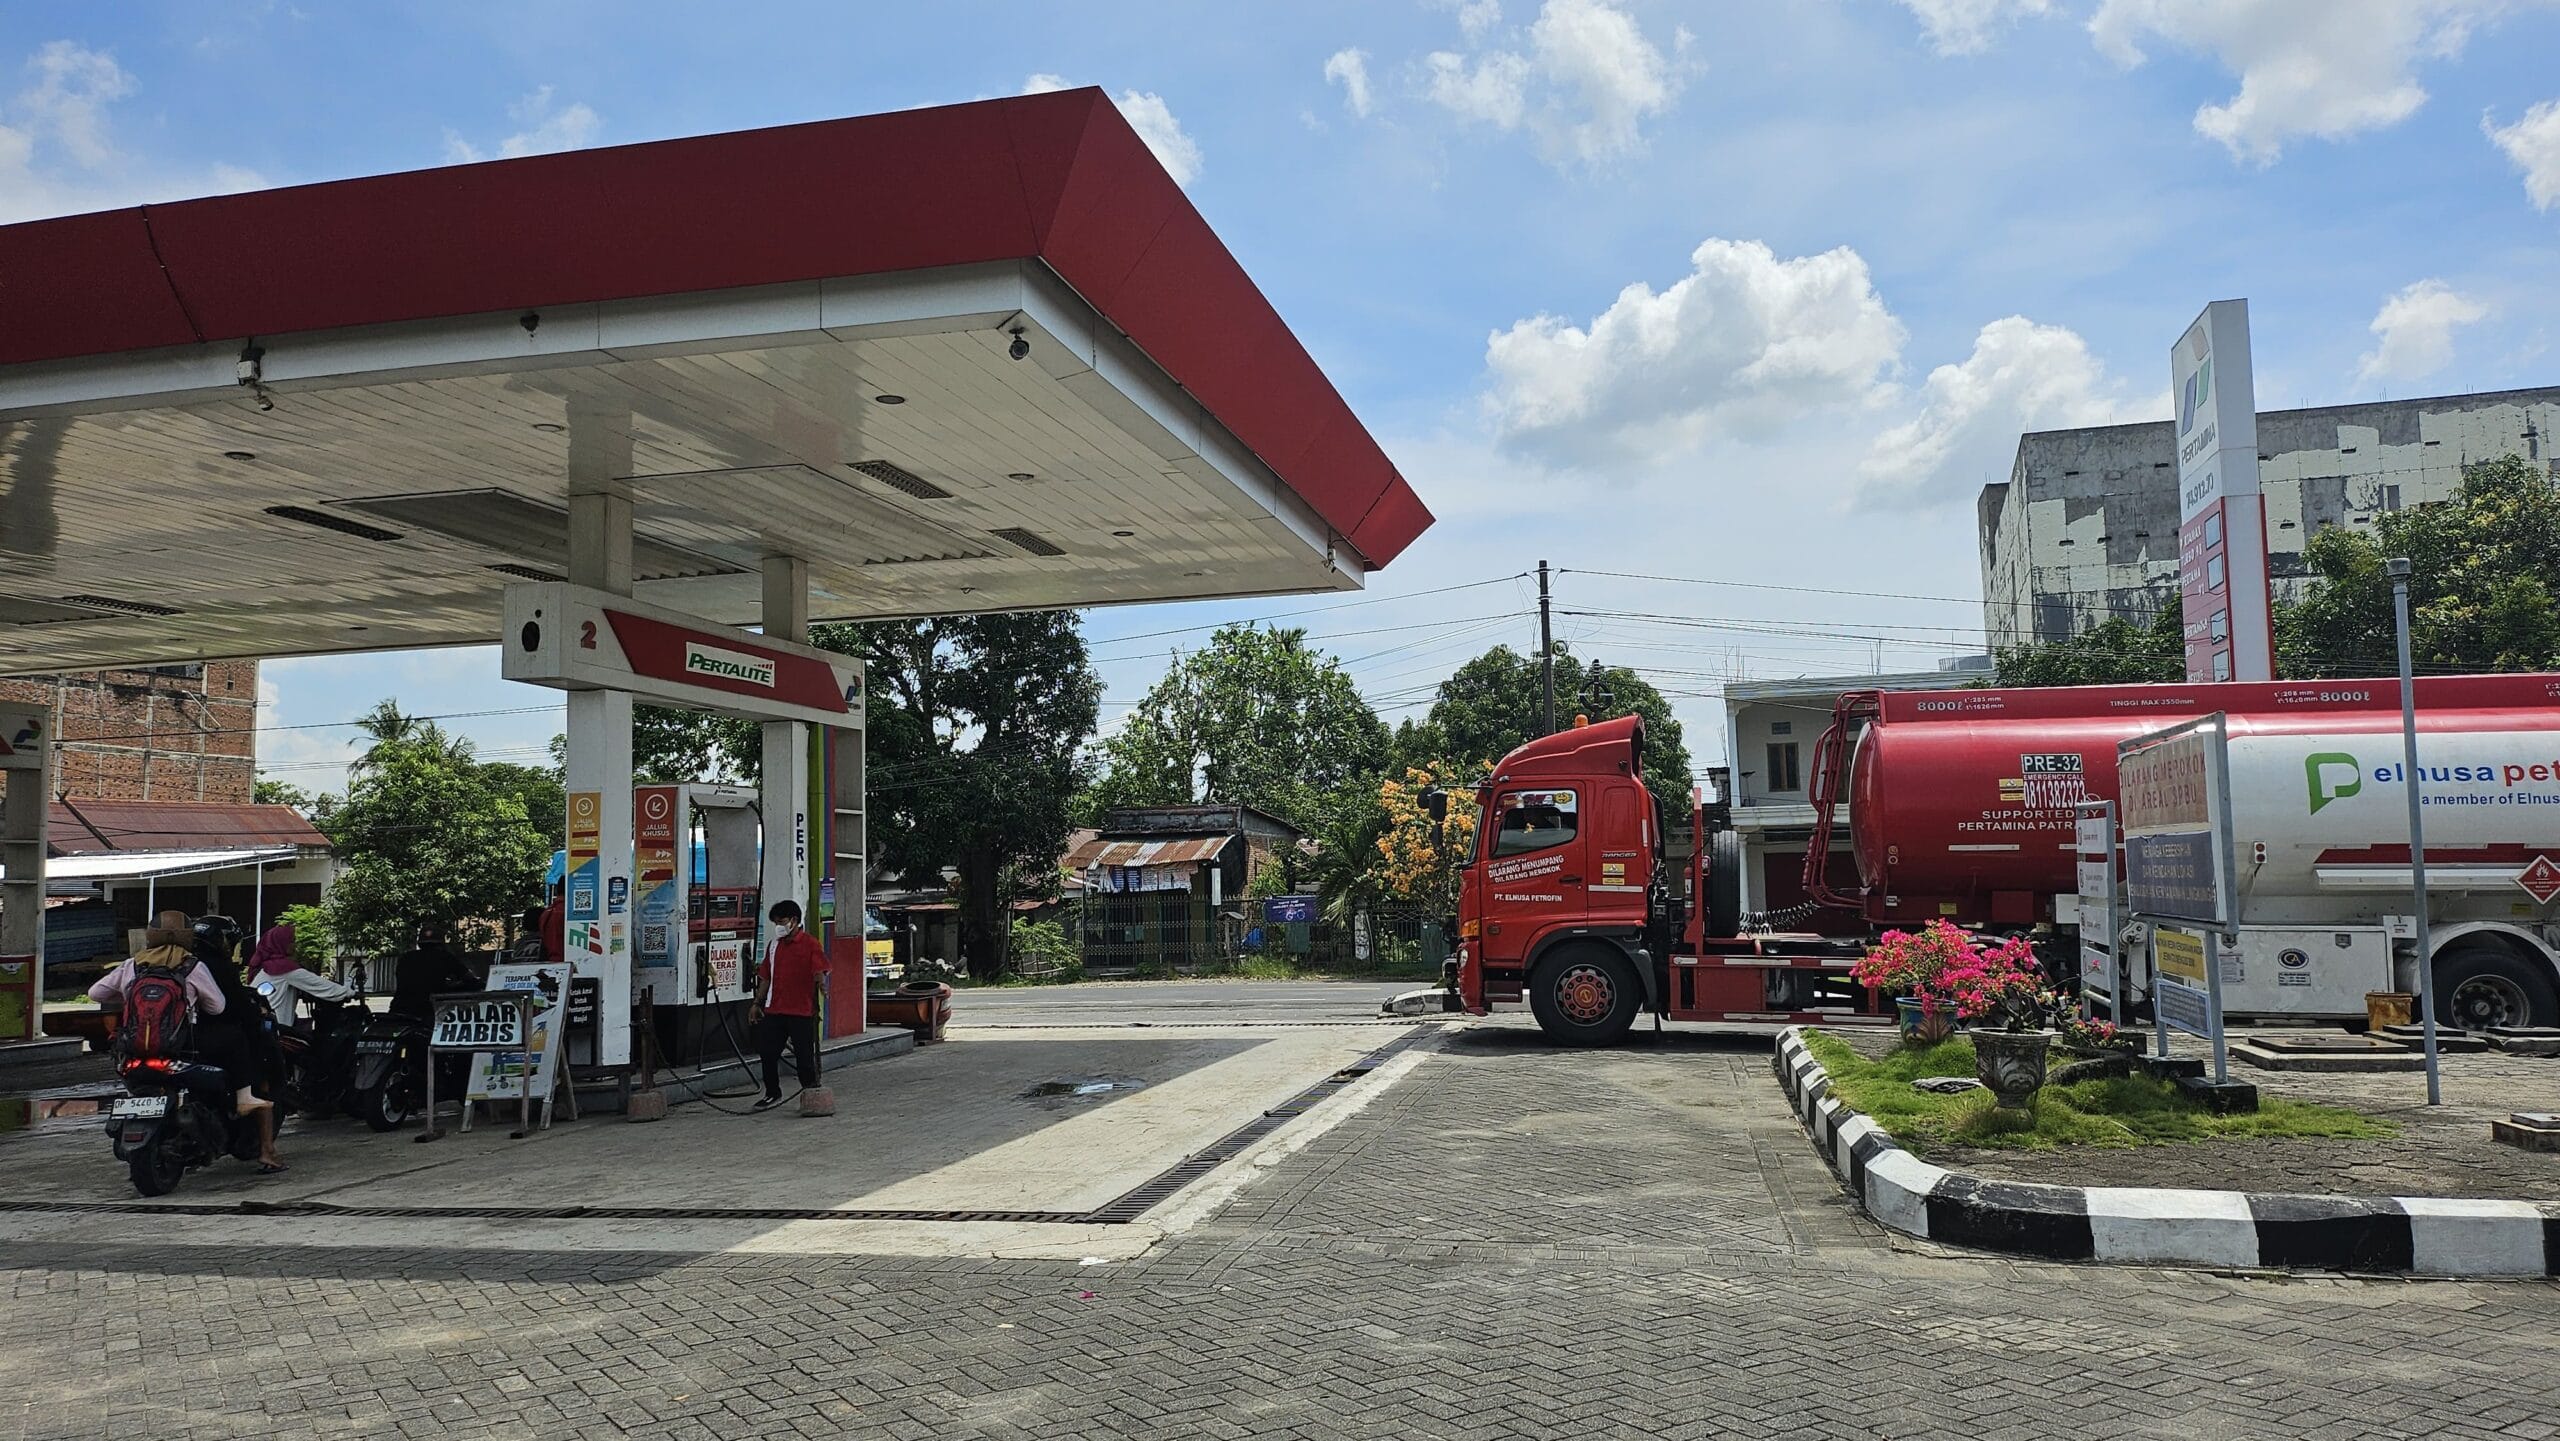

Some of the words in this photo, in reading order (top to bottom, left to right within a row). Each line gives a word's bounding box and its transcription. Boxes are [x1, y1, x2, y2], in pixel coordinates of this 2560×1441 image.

[581, 620, 597, 650] 2
[688, 652, 772, 684] PERTALITE
[2110, 699, 2139, 707] TINGGI
[2023, 756, 2081, 772] PRE-32
[2067, 773, 2086, 781] CALL
[2023, 780, 2087, 809] 0811382323
[2422, 796, 2430, 806] a
[2434, 794, 2494, 806] member
[2498, 793, 2513, 805] of
[1982, 810, 2073, 820] SUPPORTED
[1958, 822, 2036, 831] PERTAMINA
[1488, 864, 1521, 878] DILARANG
[1521, 854, 1565, 872] MENUMPANG
[1494, 871, 1529, 883] DILARANG
[1529, 865, 1562, 877] MEROKOK
[1494, 893, 1504, 901] PT.
[1531, 894, 1562, 902] PETROFIN
[711, 949, 737, 961] DILARANG
[713, 961, 737, 970] ERAS
[440, 1023, 514, 1043] HABIS
